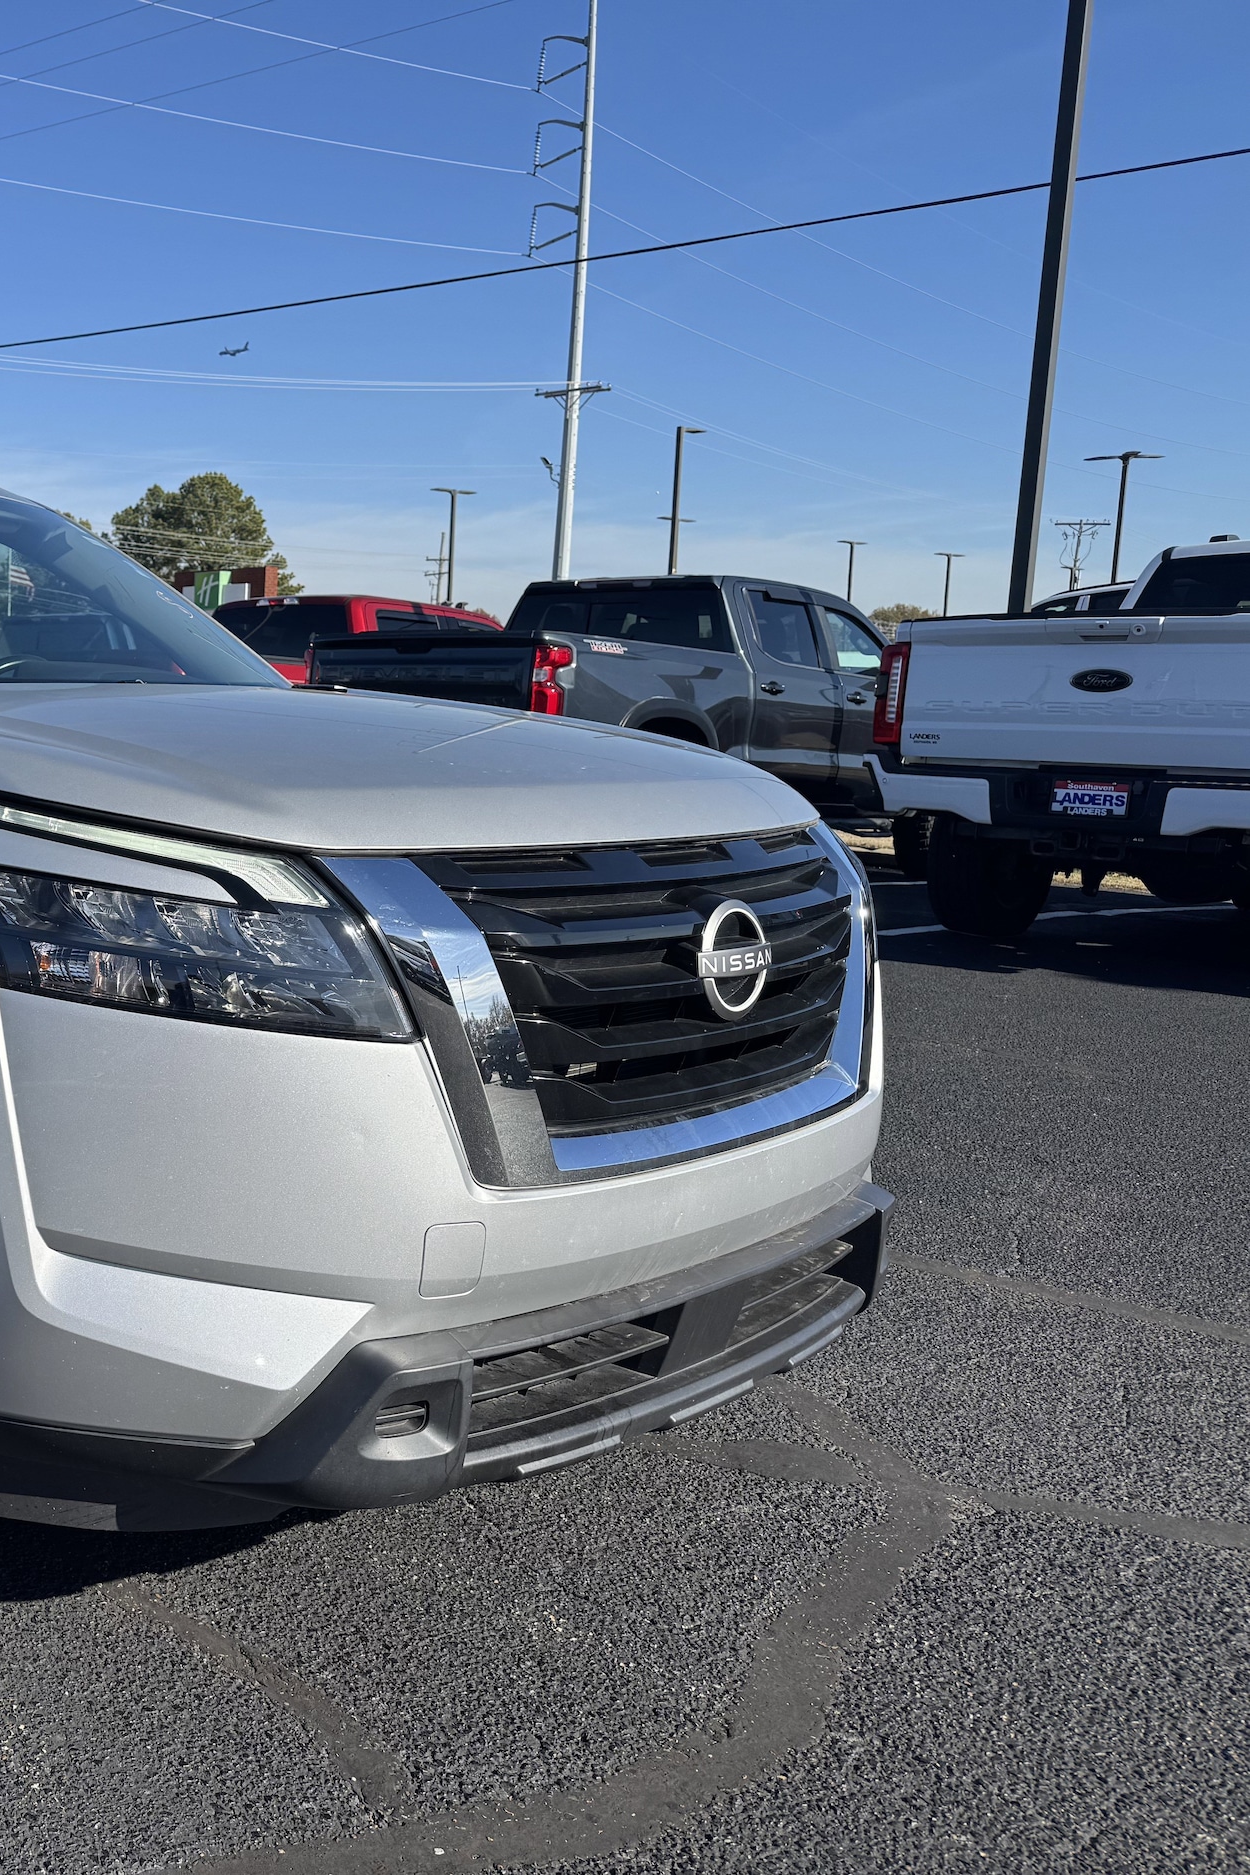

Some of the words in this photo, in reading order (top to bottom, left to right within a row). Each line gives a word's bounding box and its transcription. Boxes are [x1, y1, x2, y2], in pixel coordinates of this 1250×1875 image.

[1082, 673, 1118, 687] Ford
[925, 700, 1113, 715] SUPER
[1067, 783, 1114, 791] Southaven
[1053, 792, 1126, 807] LANDERS
[1067, 806, 1108, 816] LANDERS
[701, 948, 772, 974] NISSAN
